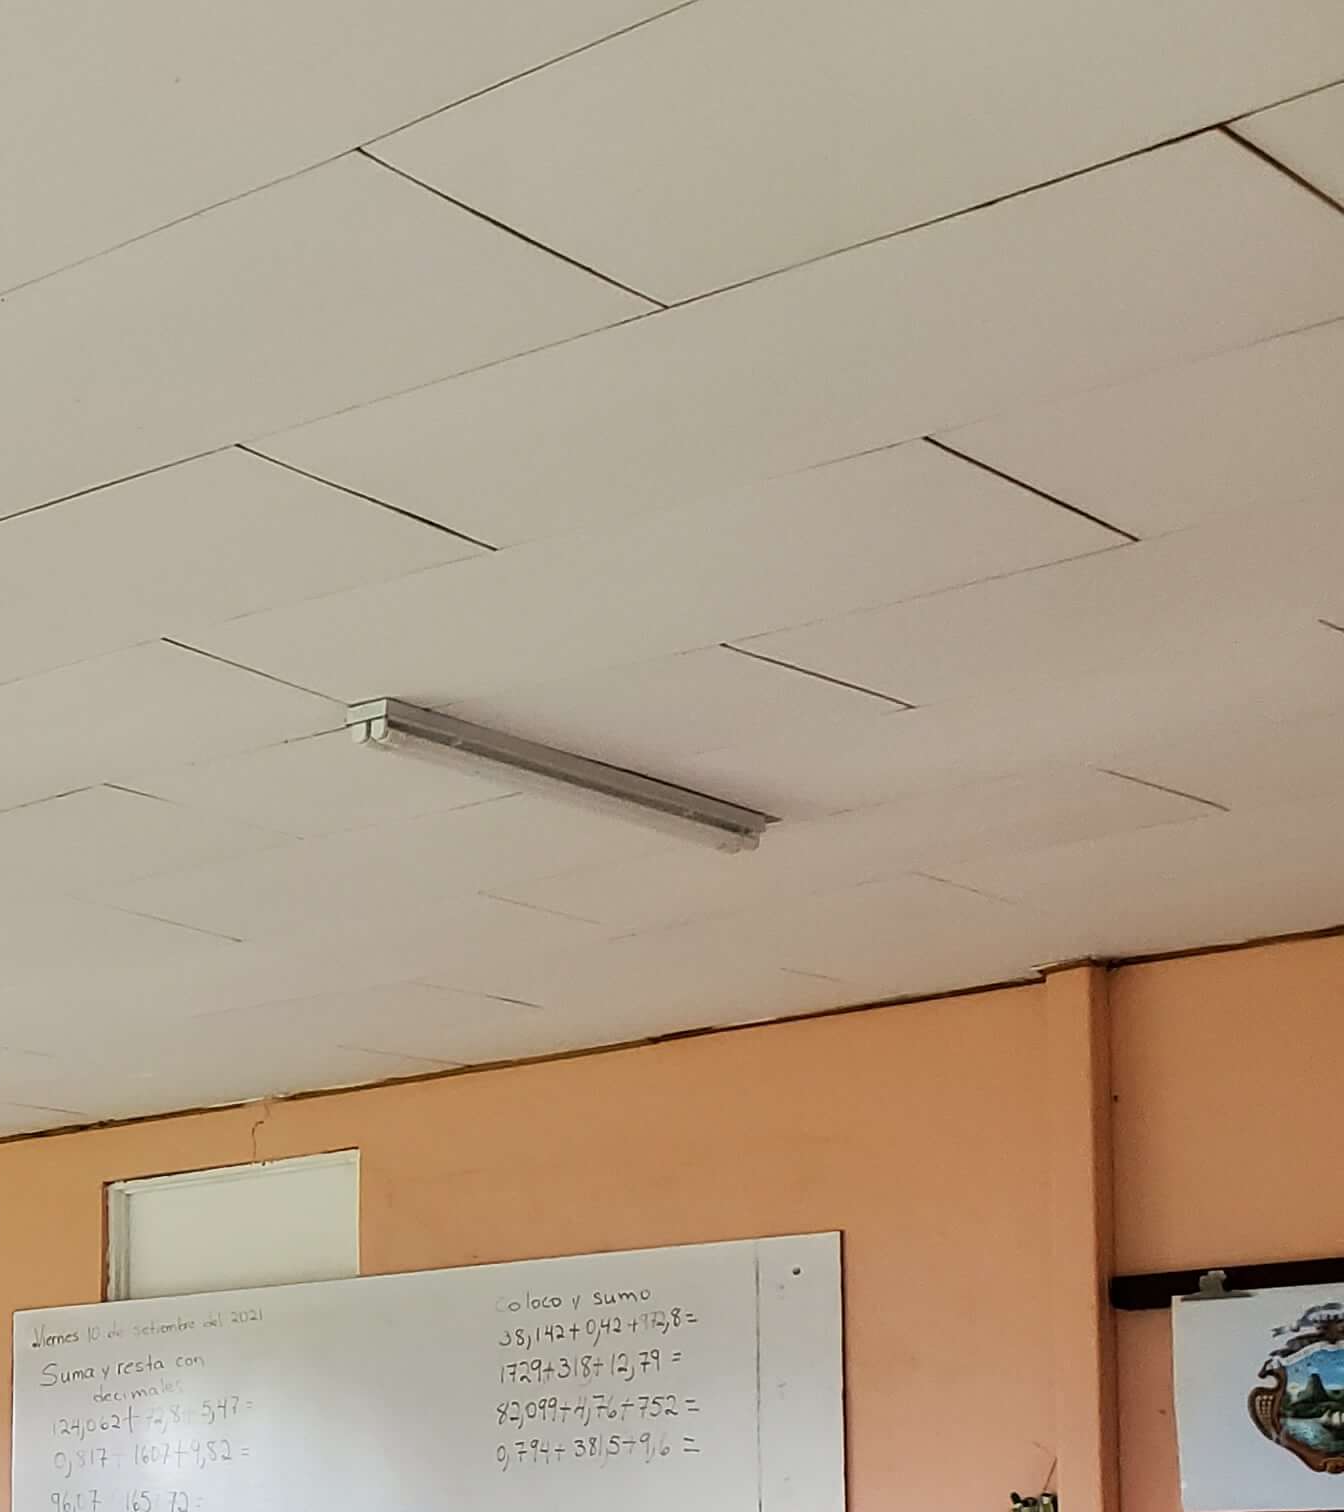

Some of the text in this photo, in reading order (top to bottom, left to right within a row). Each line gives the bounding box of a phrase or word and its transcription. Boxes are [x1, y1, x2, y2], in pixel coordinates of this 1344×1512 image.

[592, 1288, 651, 1306] sumo
[230, 1306, 265, 1324] 2021
[39, 1362, 95, 1388] Suma
[117, 1353, 165, 1377] resta
